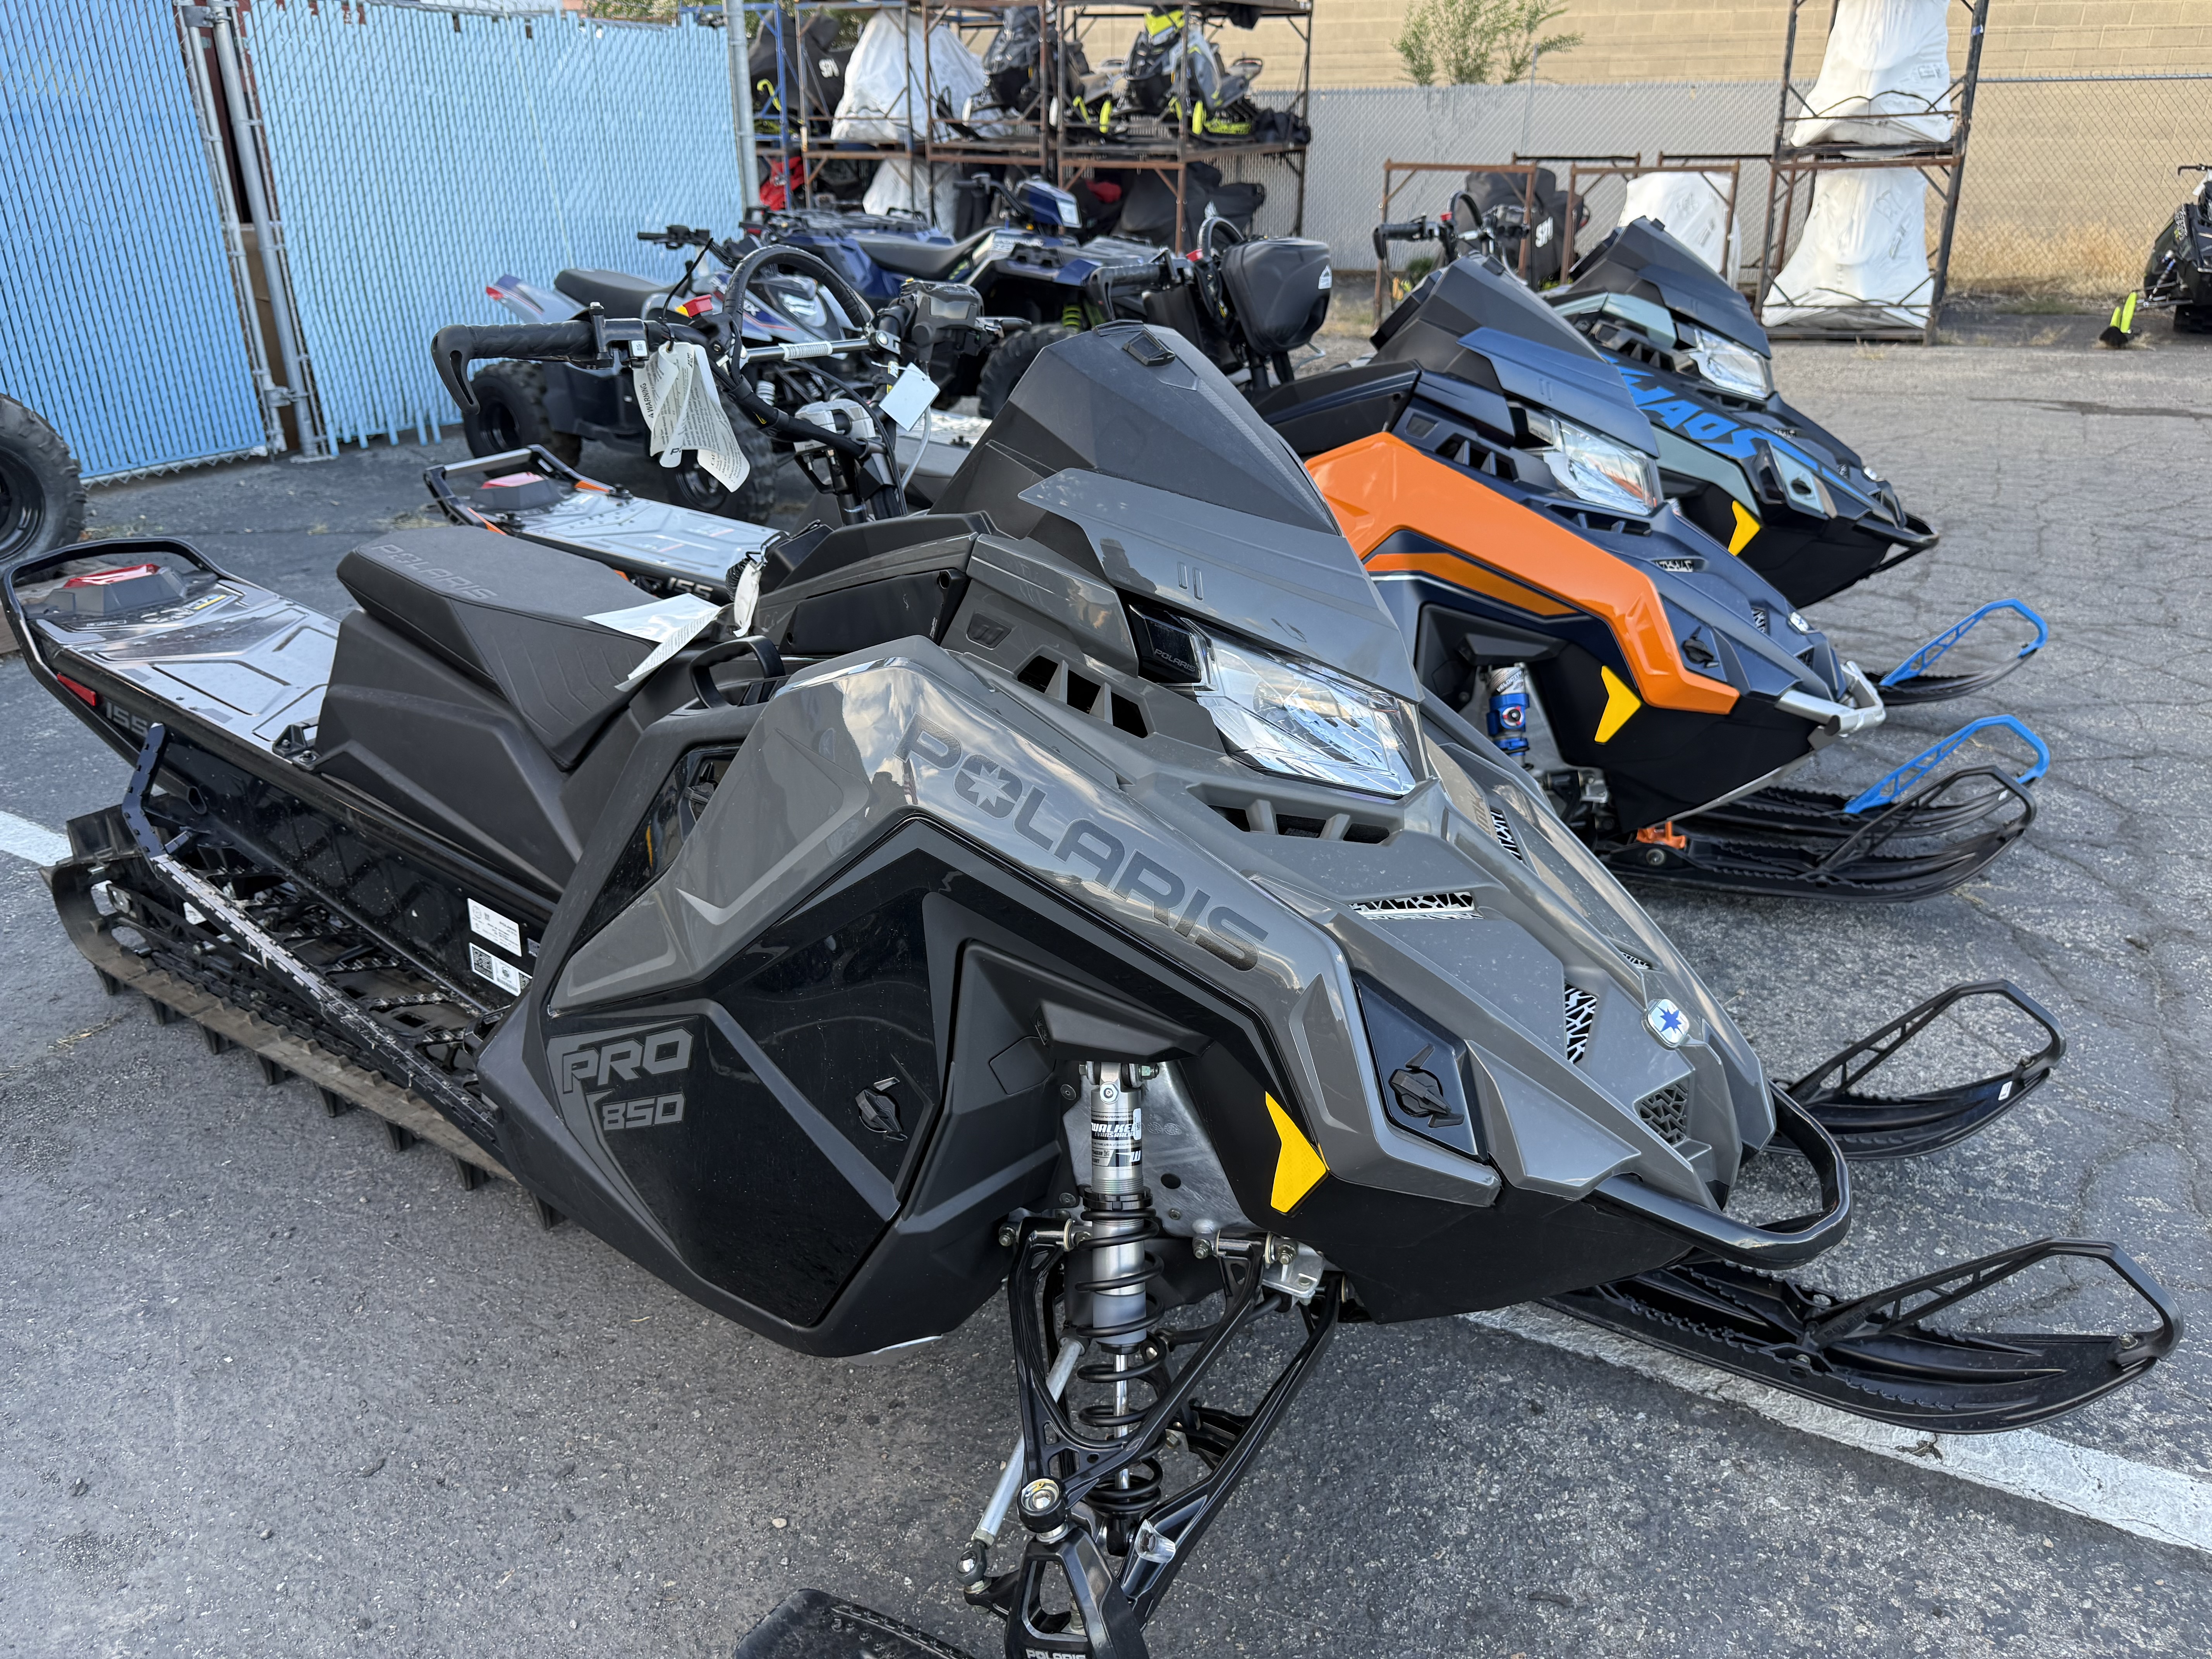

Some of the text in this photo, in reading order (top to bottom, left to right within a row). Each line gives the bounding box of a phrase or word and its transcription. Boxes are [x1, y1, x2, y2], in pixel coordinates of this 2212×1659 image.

[640, 383, 654, 413] WARNING
[371, 544, 498, 599] POLARIS
[666, 576, 713, 600] 155
[1154, 648, 1196, 672] POLARIS
[106, 701, 149, 738] 155
[892, 711, 1269, 972] POLARIS
[563, 1026, 694, 1094] PRO
[602, 1091, 686, 1131] 850
